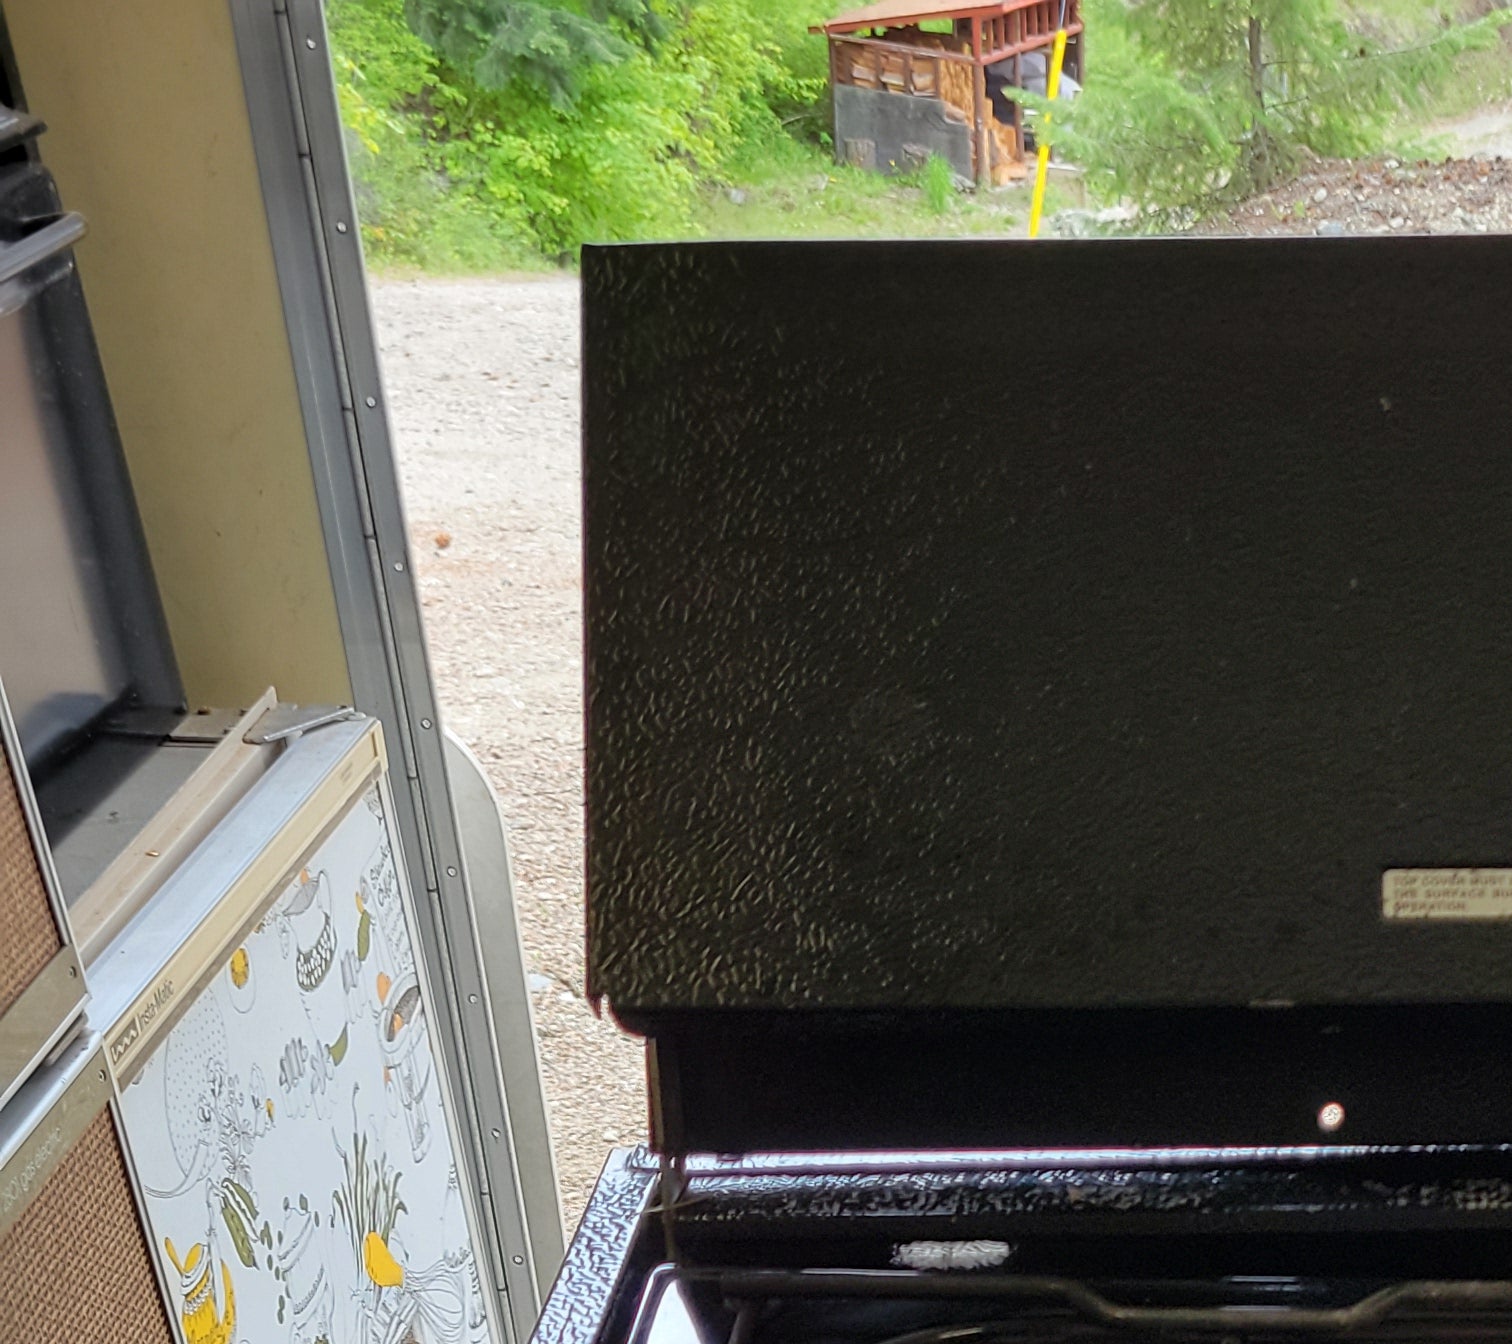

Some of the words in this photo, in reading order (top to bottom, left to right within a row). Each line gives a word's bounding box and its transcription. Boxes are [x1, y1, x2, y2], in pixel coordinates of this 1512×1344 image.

[1421, 875, 1465, 887] COVER
[1470, 874, 1505, 886] MUST
[1424, 887, 1486, 899] SURFACE
